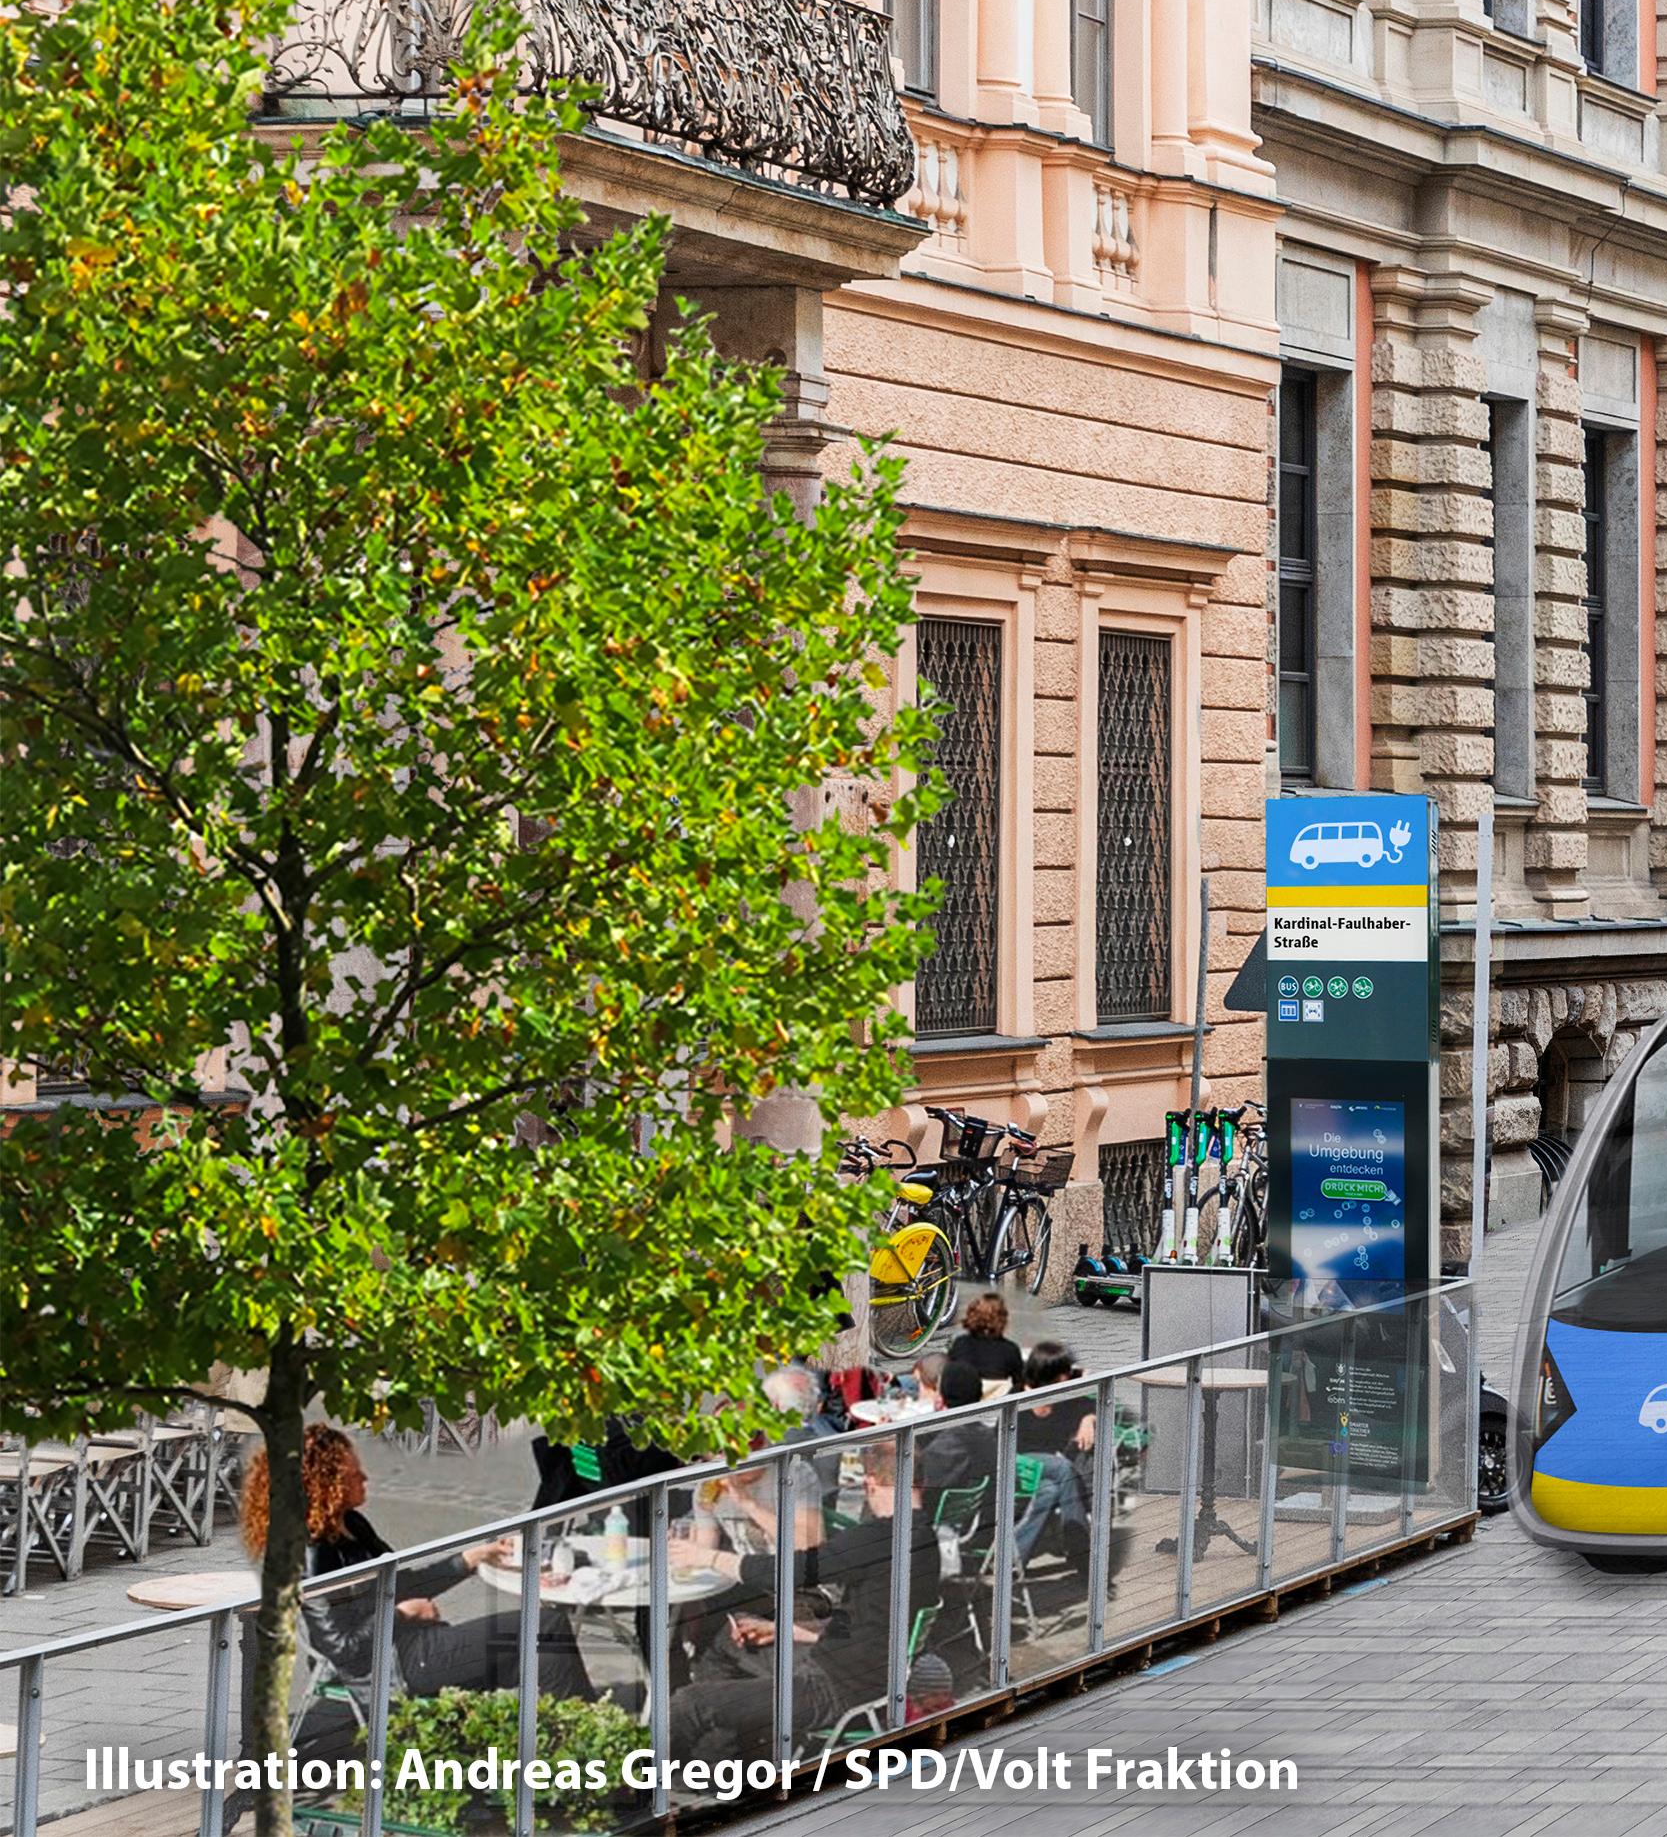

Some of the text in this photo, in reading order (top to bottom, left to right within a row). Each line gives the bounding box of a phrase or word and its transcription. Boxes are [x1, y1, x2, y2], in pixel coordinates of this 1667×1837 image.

[1273, 916, 1412, 930] Kardinal-Faulhaber-
[1273, 935, 1319, 948] Straße
[1280, 982, 1297, 991] BUS
[1323, 1132, 1342, 1143] Die
[1309, 1144, 1384, 1163] Umgebung
[1329, 1164, 1384, 1175] entdecken
[1324, 1182, 1355, 1192] DRÜCK
